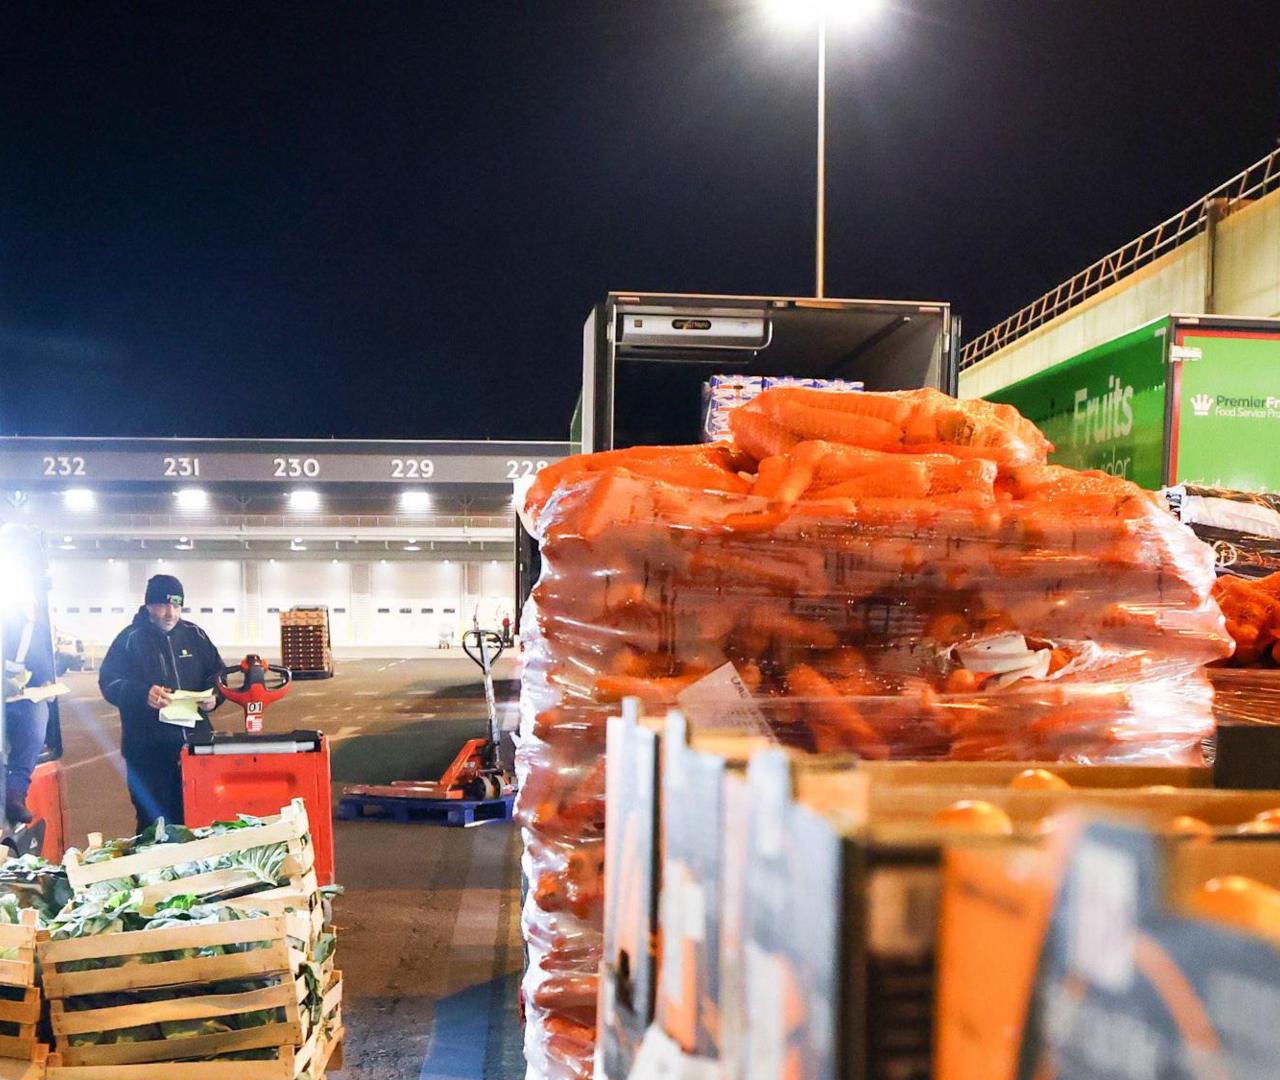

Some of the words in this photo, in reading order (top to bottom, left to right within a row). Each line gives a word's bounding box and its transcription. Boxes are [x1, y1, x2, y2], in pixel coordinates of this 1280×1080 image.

[1073, 374, 1134, 450] Fruits
[1215, 407, 1236, 417] Food
[43, 456, 86, 476] 232
[164, 457, 200, 477] 231
[273, 458, 320, 477] 230
[391, 459, 435, 478] 229
